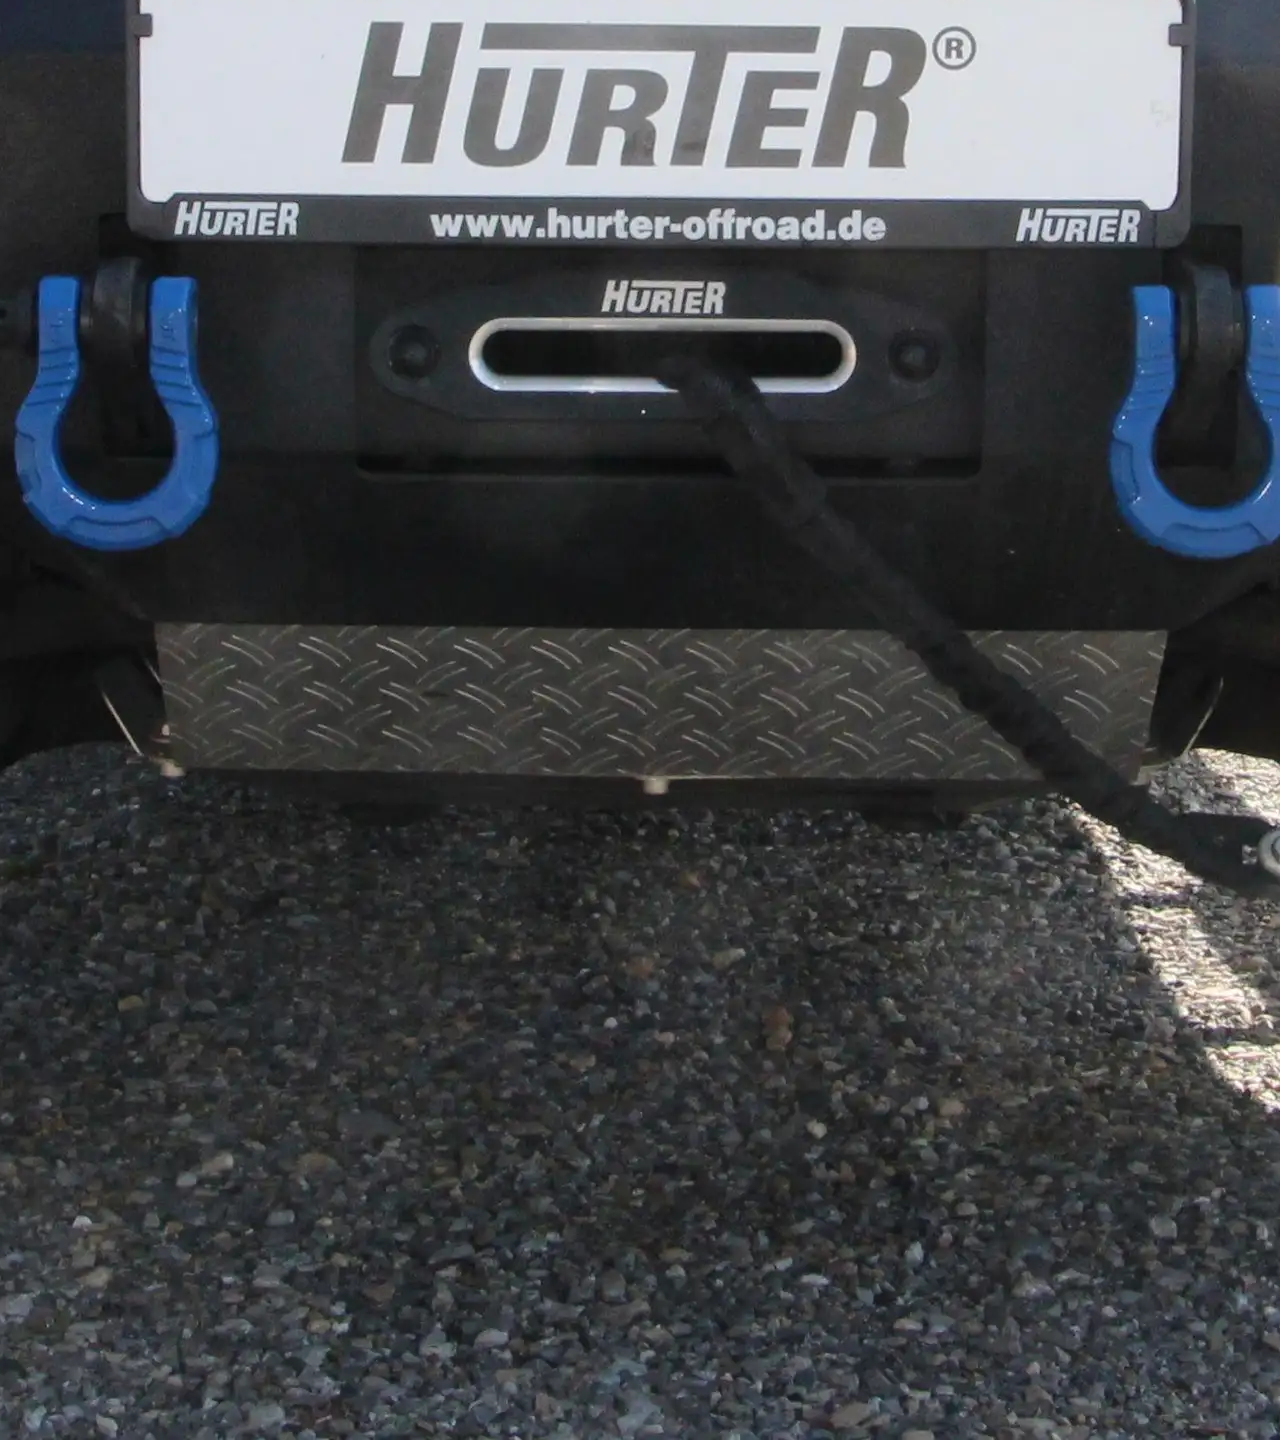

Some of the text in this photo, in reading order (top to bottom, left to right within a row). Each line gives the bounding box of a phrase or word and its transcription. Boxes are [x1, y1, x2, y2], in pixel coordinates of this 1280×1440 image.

[174, 200, 300, 236] HURTER
[430, 208, 887, 241] www.hurter-offroad.de
[1015, 207, 1141, 243] HURTER
[601, 279, 726, 315] HURTER
